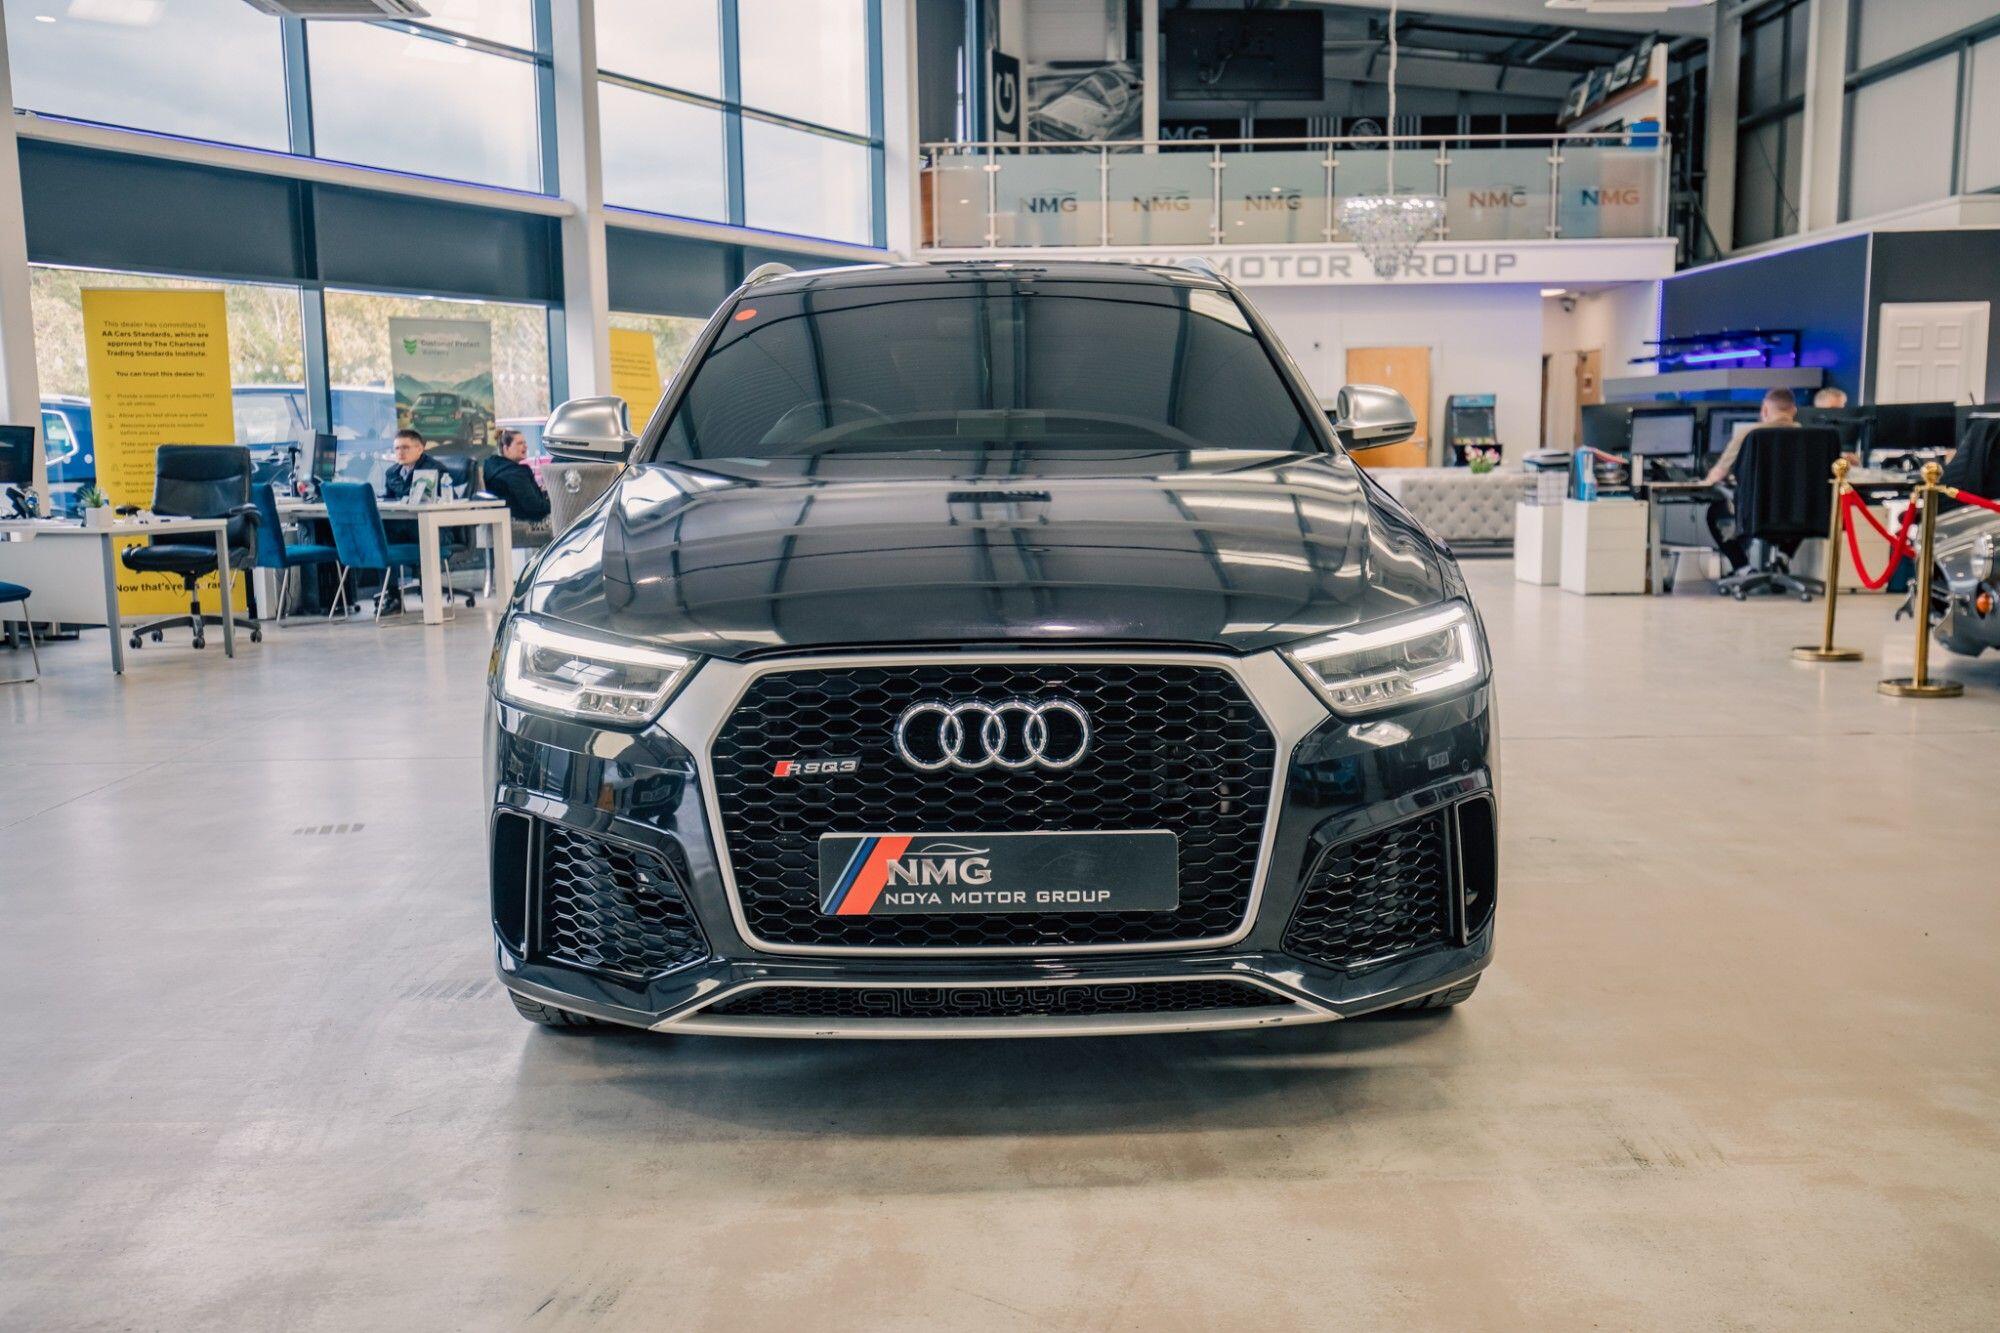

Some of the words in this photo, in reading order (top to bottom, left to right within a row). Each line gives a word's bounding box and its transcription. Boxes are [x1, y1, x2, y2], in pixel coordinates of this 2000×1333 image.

[1021, 197, 1078, 213] NMG
[1133, 196, 1191, 212] NMG
[1246, 195, 1303, 212] NMG
[1581, 189, 1639, 206] NMG
[104, 320, 119, 328] This
[120, 320, 143, 328] dealer
[158, 321, 197, 329] committed
[114, 330, 132, 338] Cars
[133, 330, 173, 339] Standards,
[107, 340, 142, 348] approved
[143, 340, 153, 348] by
[106, 350, 135, 358] Trading
[141, 581, 170, 592] that's
[886, 857, 992, 886] NMG
[885, 892, 942, 905] NOYA
[951, 890, 1026, 904] MOTOR
[1036, 889, 1111, 903] GROUP
[858, 984, 1136, 1015] quattro
